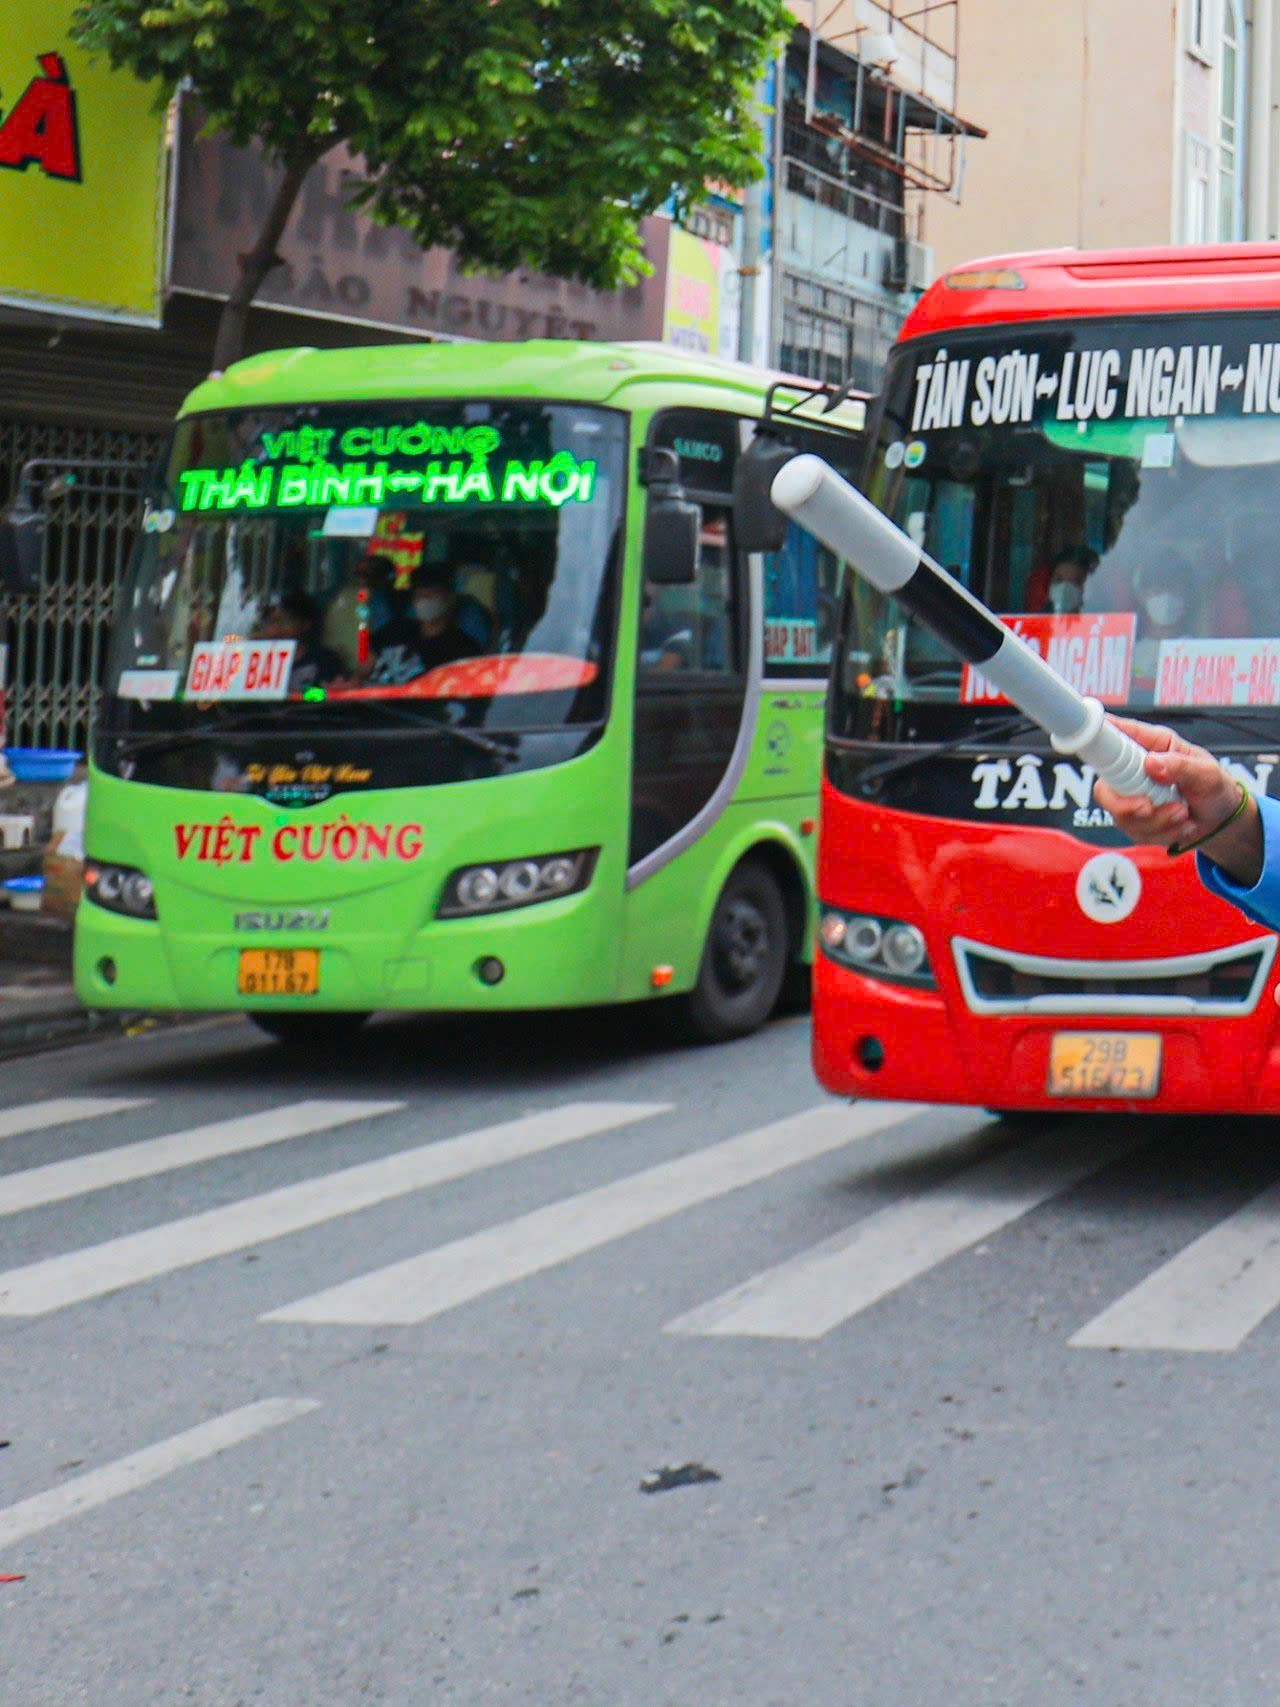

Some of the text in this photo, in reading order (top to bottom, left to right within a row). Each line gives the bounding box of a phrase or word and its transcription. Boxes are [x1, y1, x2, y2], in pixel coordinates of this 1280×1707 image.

[911, 348, 971, 432] TÂN
[971, 349, 1040, 427] SƠN
[1056, 350, 1121, 433] LỤC
[1124, 345, 1222, 429] NGẠN
[179, 457, 274, 511] THÁI
[501, 449, 597, 507] NỘI
[971, 755, 1096, 809] TÂN
[174, 813, 423, 868] VIỆT CƯỜNG
[233, 908, 329, 932] ISUZU
